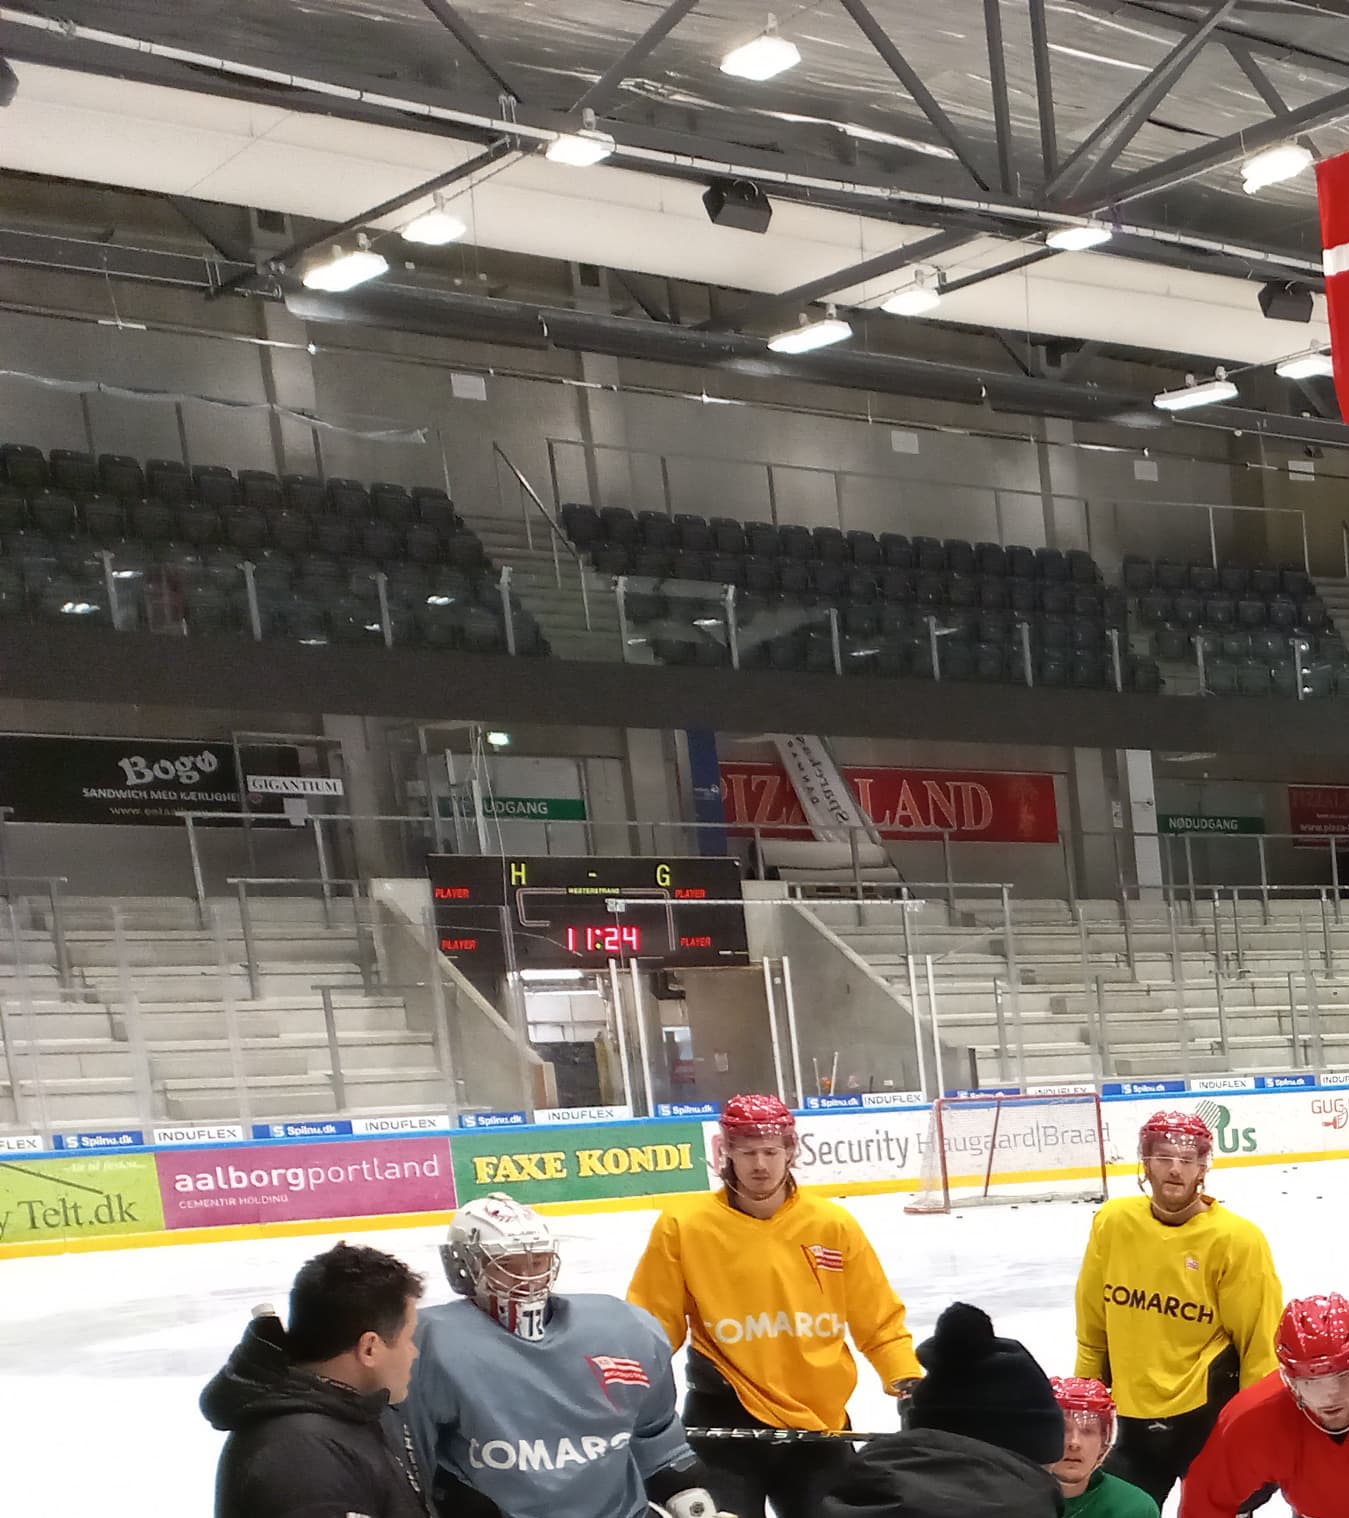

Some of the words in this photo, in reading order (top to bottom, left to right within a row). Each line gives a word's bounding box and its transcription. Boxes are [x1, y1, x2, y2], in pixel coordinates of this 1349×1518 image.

[82, 786, 148, 800] SANDWICH
[252, 779, 340, 793] GIGANTIUM
[1168, 815, 1239, 831] NØDUDGANG
[510, 863, 526, 885] H
[656, 864, 671, 886] G
[434, 888, 470, 900] PLAYER
[675, 888, 706, 900] PLAYER
[441, 938, 477, 951] PLAYER
[567, 926, 641, 952] 11:24
[680, 936, 712, 948] PLAYER
[1198, 1079, 1247, 1091] INDUFLEX
[862, 1092, 922, 1106] INDUFLEX
[1311, 1098, 1345, 1115] GUG
[548, 1107, 615, 1122] INDUFLEX
[363, 1117, 438, 1132] INDUFLEX
[158, 1128, 238, 1142] INDUFLEX
[801, 1125, 910, 1173] Security
[473, 1150, 568, 1185] FAXE
[575, 1142, 694, 1179] KONDI
[173, 1154, 440, 1192] aalborgportland
[178, 1197, 237, 1210] CEMENTIR
[16, 1193, 140, 1230] Telt.dk
[1103, 1283, 1215, 1326] COMARCH
